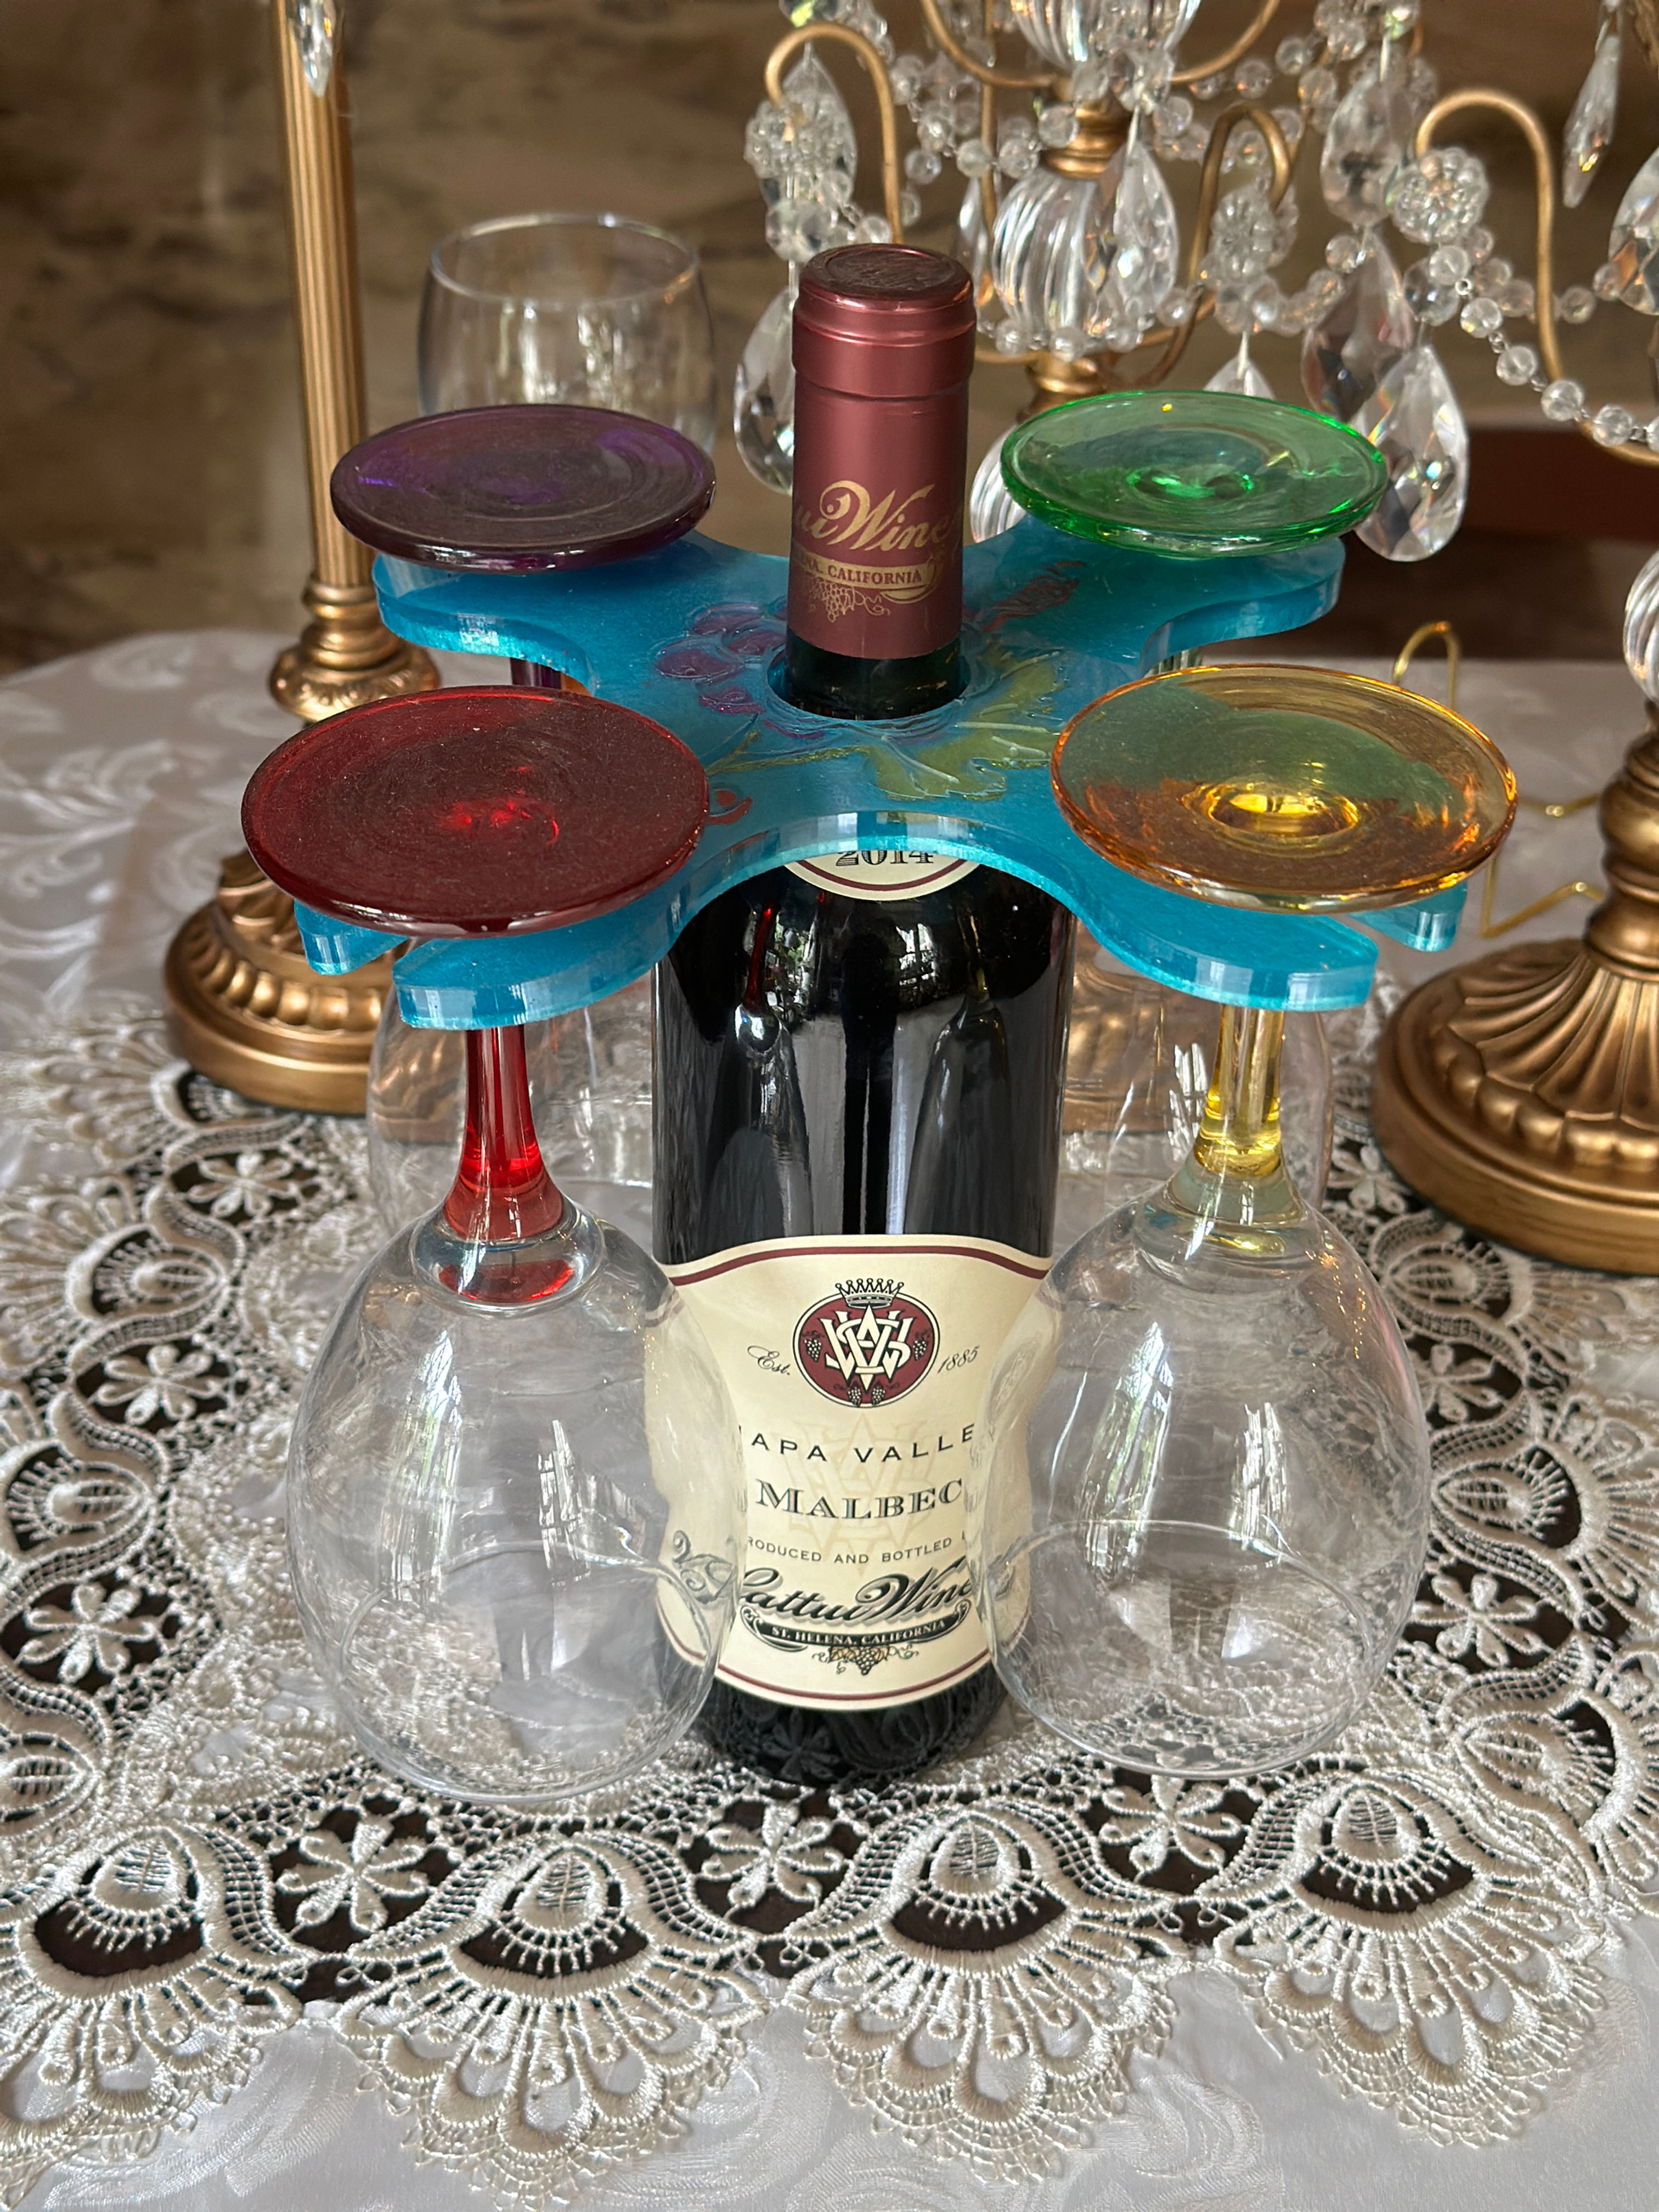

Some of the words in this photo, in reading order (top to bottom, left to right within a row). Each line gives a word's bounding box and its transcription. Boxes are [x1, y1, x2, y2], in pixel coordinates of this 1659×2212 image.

[820, 479, 952, 551] Wine
[827, 564, 923, 585] CALIFORNIA
[836, 850, 934, 867] 2014
[747, 1345, 791, 1376] Est.
[937, 1345, 980, 1374] 1885
[739, 1425, 827, 1462] APA
[854, 1423, 975, 1463] VALLE
[755, 1478, 963, 1519] MALBEC
[748, 1536, 822, 1562] RODUCED
[833, 1554, 870, 1564] AND
[882, 1536, 952, 1563] BOTTLED
[855, 1555, 973, 1622] Wine
[772, 1626, 791, 1639] ST.
[861, 1617, 946, 1645] CALIFORNIA
